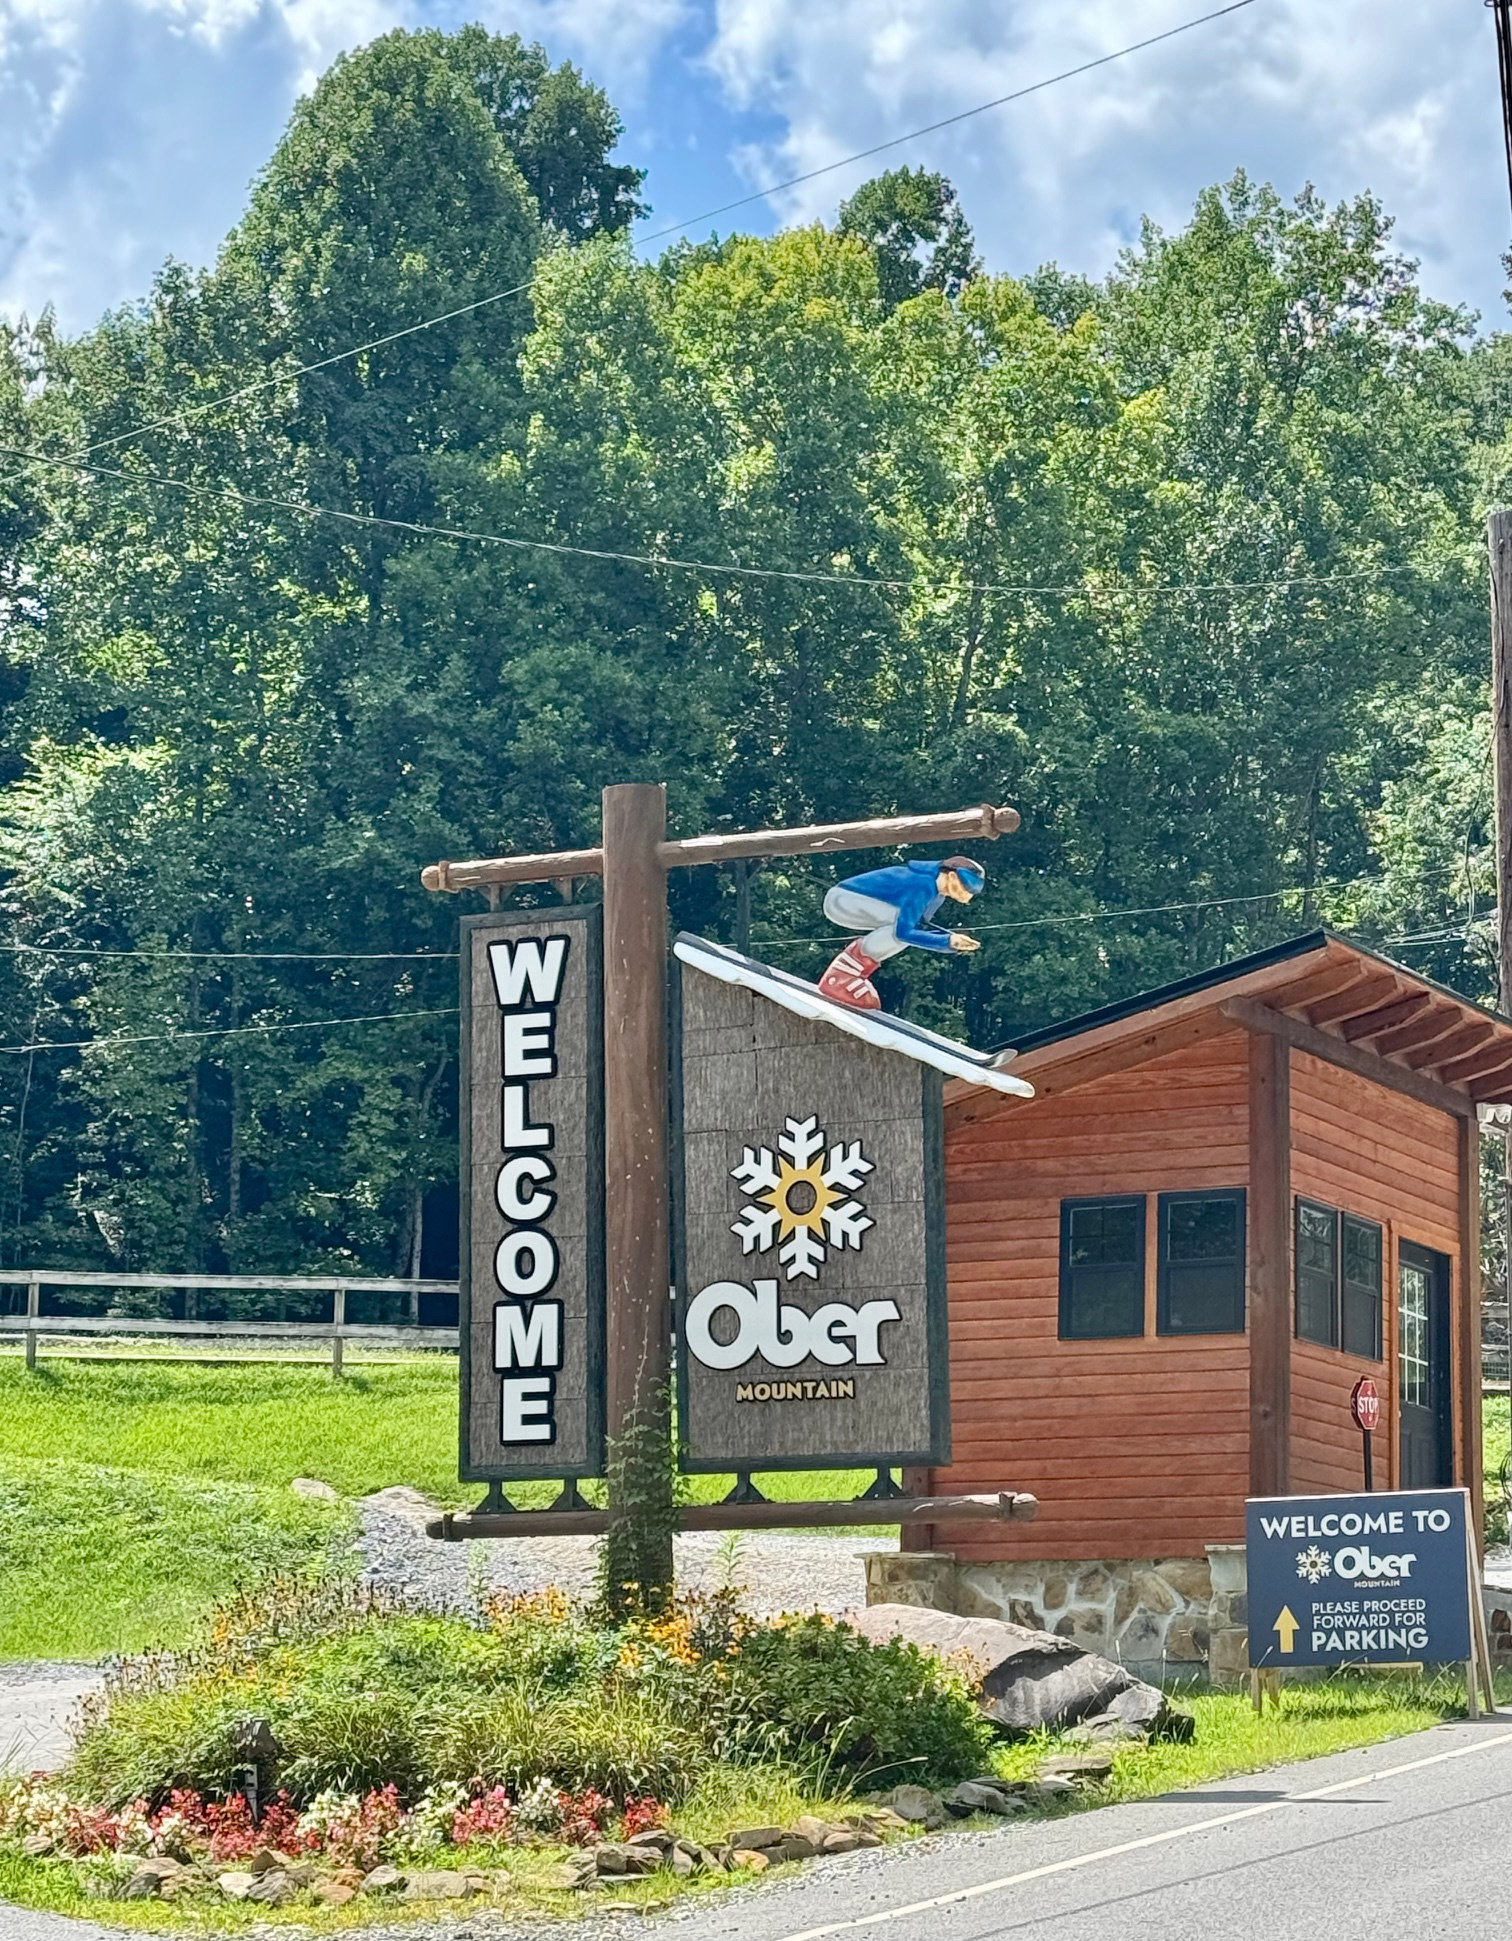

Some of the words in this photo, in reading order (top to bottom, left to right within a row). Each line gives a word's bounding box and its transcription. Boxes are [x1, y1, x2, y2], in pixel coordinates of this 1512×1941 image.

[487, 937, 567, 1444] WELCOME
[685, 1278, 901, 1370] Ober
[736, 1379, 855, 1402] MOUNTAIN
[1359, 1396, 1379, 1414] STOP
[1260, 1511, 1404, 1540] WELCOME
[1412, 1509, 1451, 1532] TO
[1333, 1545, 1418, 1579] Ober
[1354, 1579, 1400, 1588] MOUNTAIN
[1312, 1601, 1359, 1614] PLEASE
[1363, 1599, 1426, 1612] PROCEED
[1313, 1614, 1390, 1629] FORWARD
[1395, 1612, 1426, 1626] FOR
[1311, 1627, 1429, 1652] PARKING
